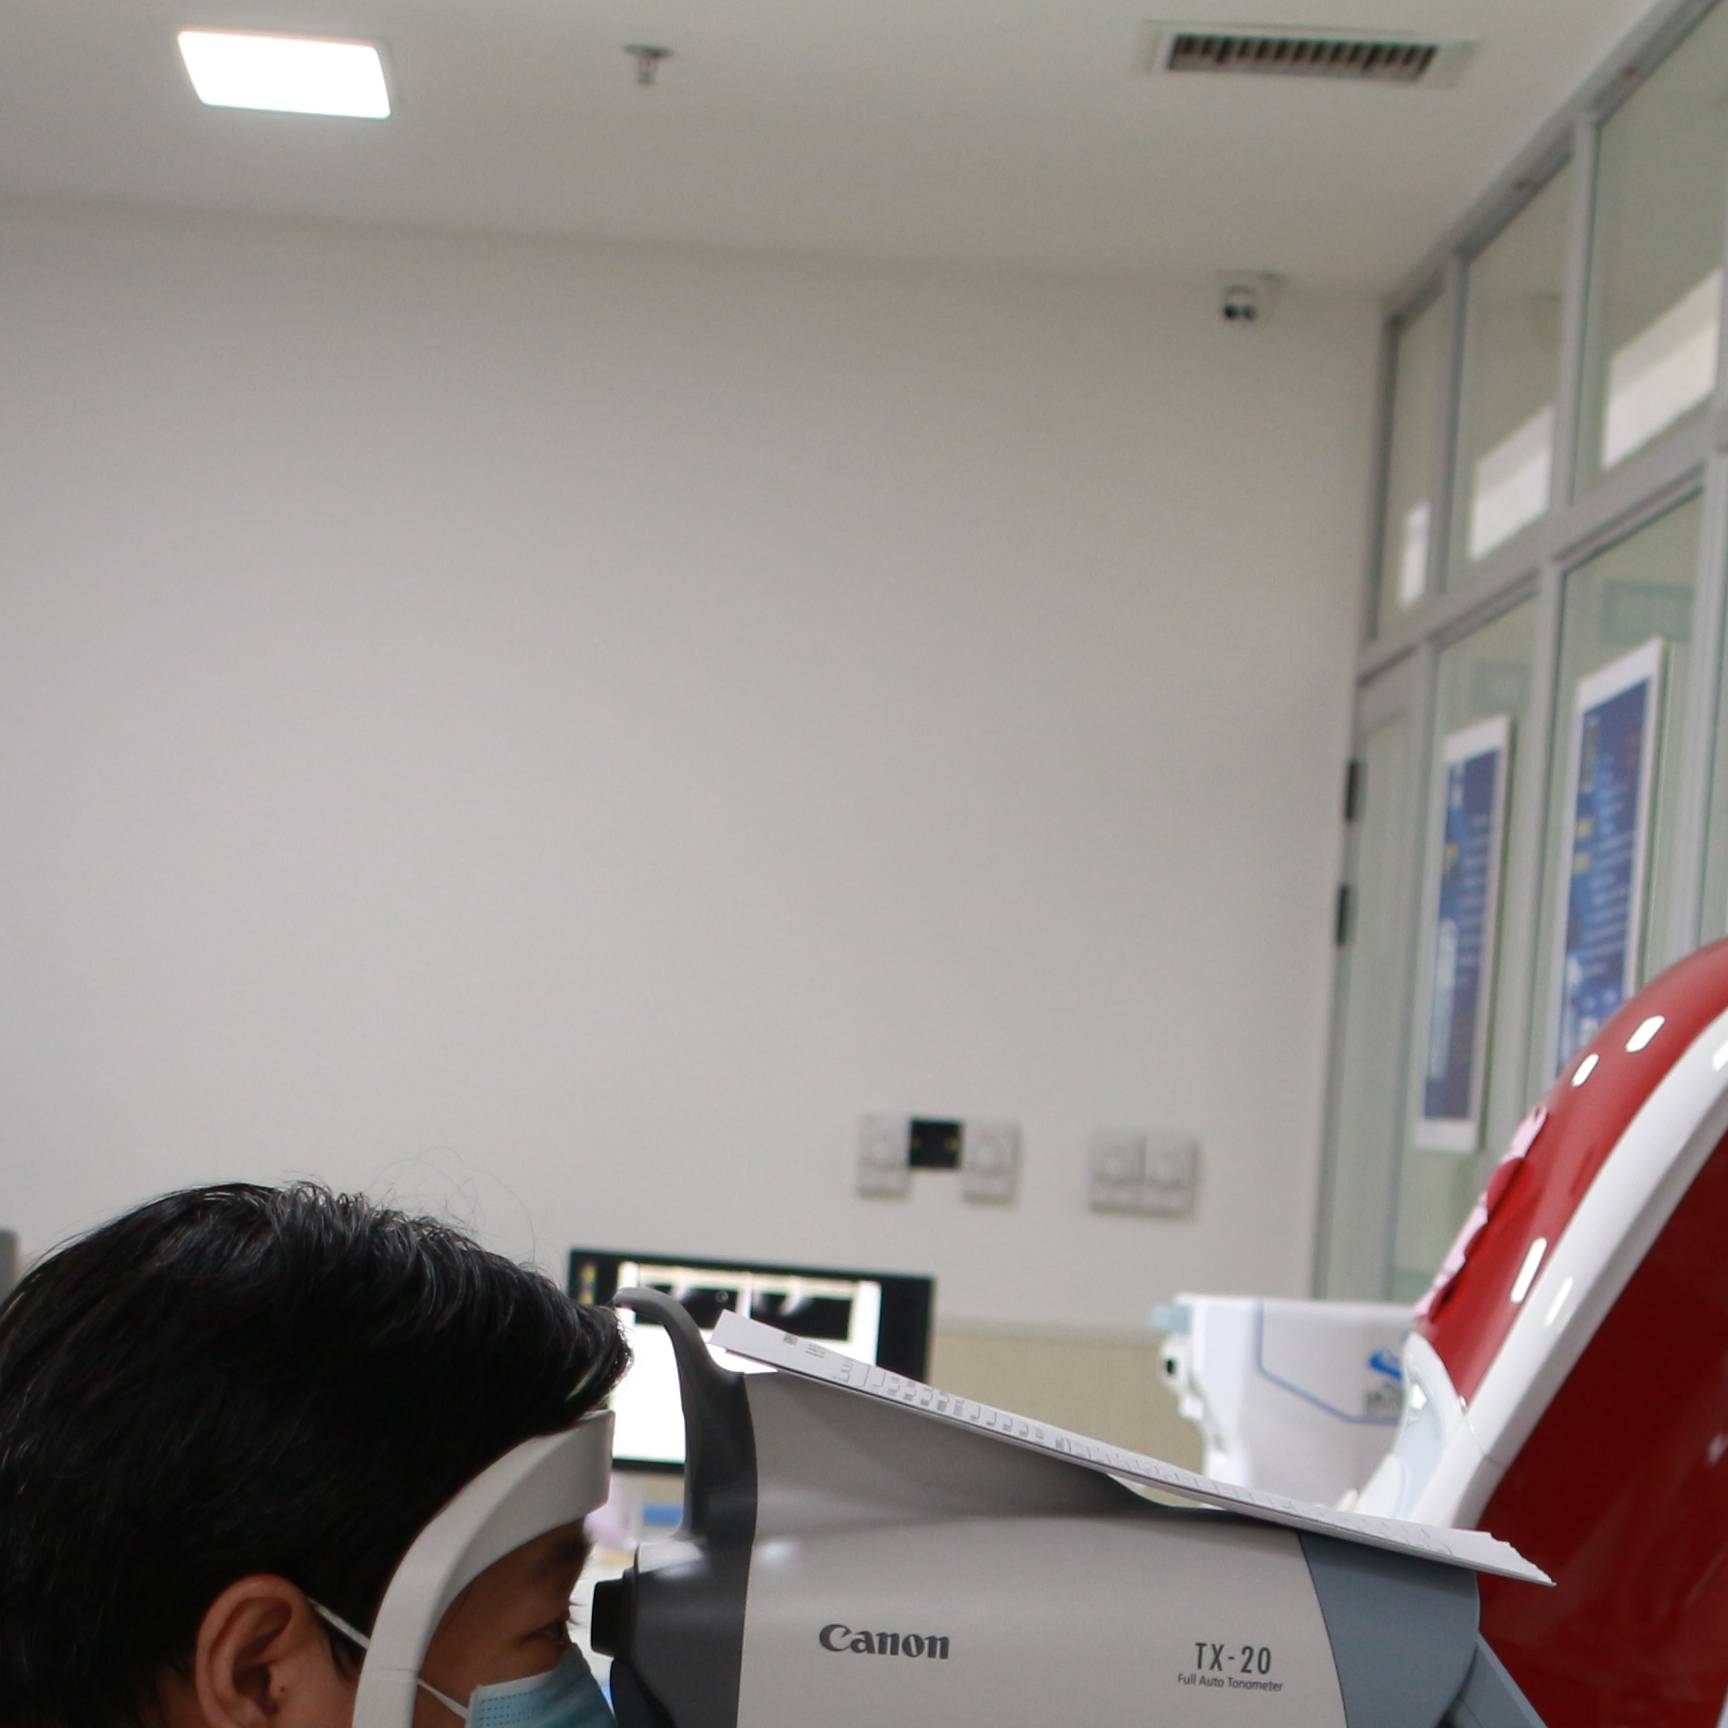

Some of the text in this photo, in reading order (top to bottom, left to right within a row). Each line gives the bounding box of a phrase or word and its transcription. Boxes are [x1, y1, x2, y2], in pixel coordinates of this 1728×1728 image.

[819, 1623, 950, 1659] Canon
[1195, 1642, 1271, 1675] TX-20
[1177, 1673, 1283, 1692] Full Auto Tonometer
